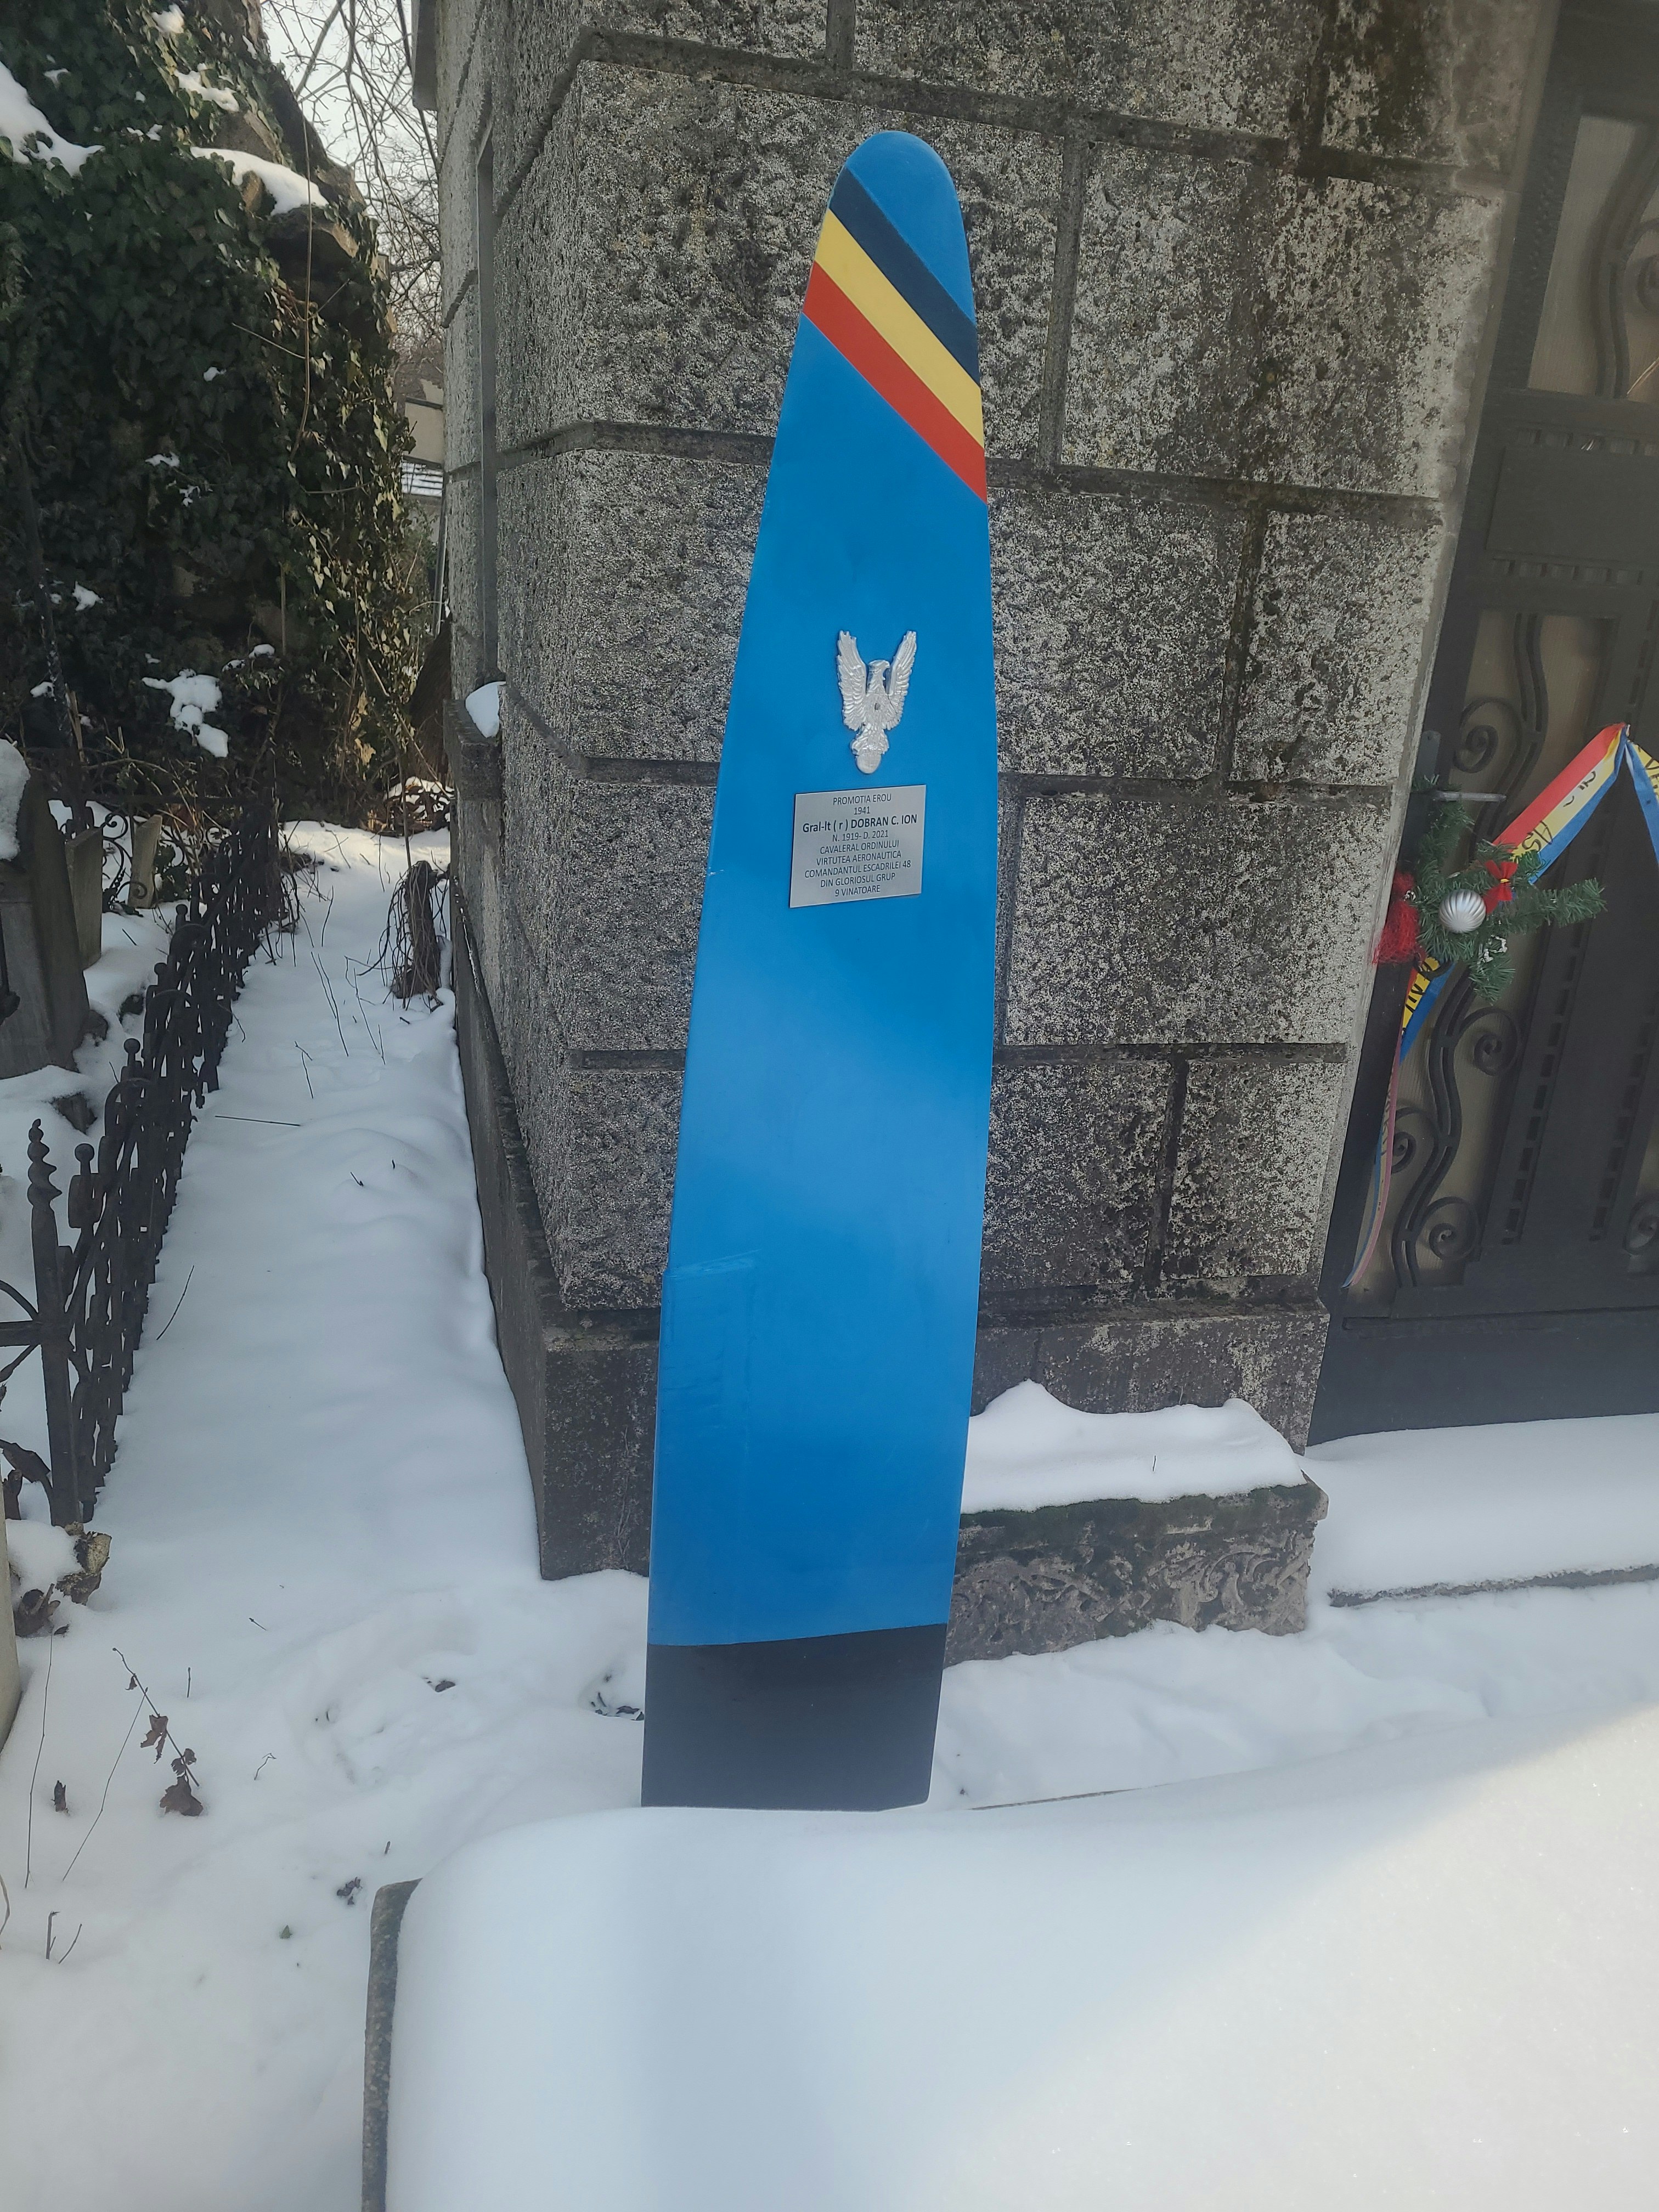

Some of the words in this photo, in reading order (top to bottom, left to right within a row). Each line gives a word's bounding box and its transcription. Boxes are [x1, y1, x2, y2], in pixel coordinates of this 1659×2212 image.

[833, 795, 871, 805] PROMOTIA
[873, 793, 891, 802] EROU
[854, 806, 871, 815] 1941
[803, 821, 831, 833] Gral-lt
[851, 816, 889, 829] DOBRAN
[891, 815, 899, 825] C.
[901, 814, 917, 825] ION
[832, 834, 840, 842] N.
[863, 831, 870, 839] D.
[872, 830, 889, 839] 2021
[820, 843, 860, 854] CAVALERAL
[861, 839, 899, 850] ORDINULUI
[816, 855, 851, 866] VIRTUTEA
[852, 850, 902, 862] AERONAUTICA
[805, 865, 861, 878] COMANDANTUL
[863, 861, 901, 872] ESCADRILEI
[902, 860, 911, 868] 48
[820, 879, 834, 888] DIN
[835, 874, 875, 886] GLORIOSUL
[876, 872, 895, 882] GRUP
[835, 889, 839, 897] 9
[842, 884, 881, 896] VINATOARE
